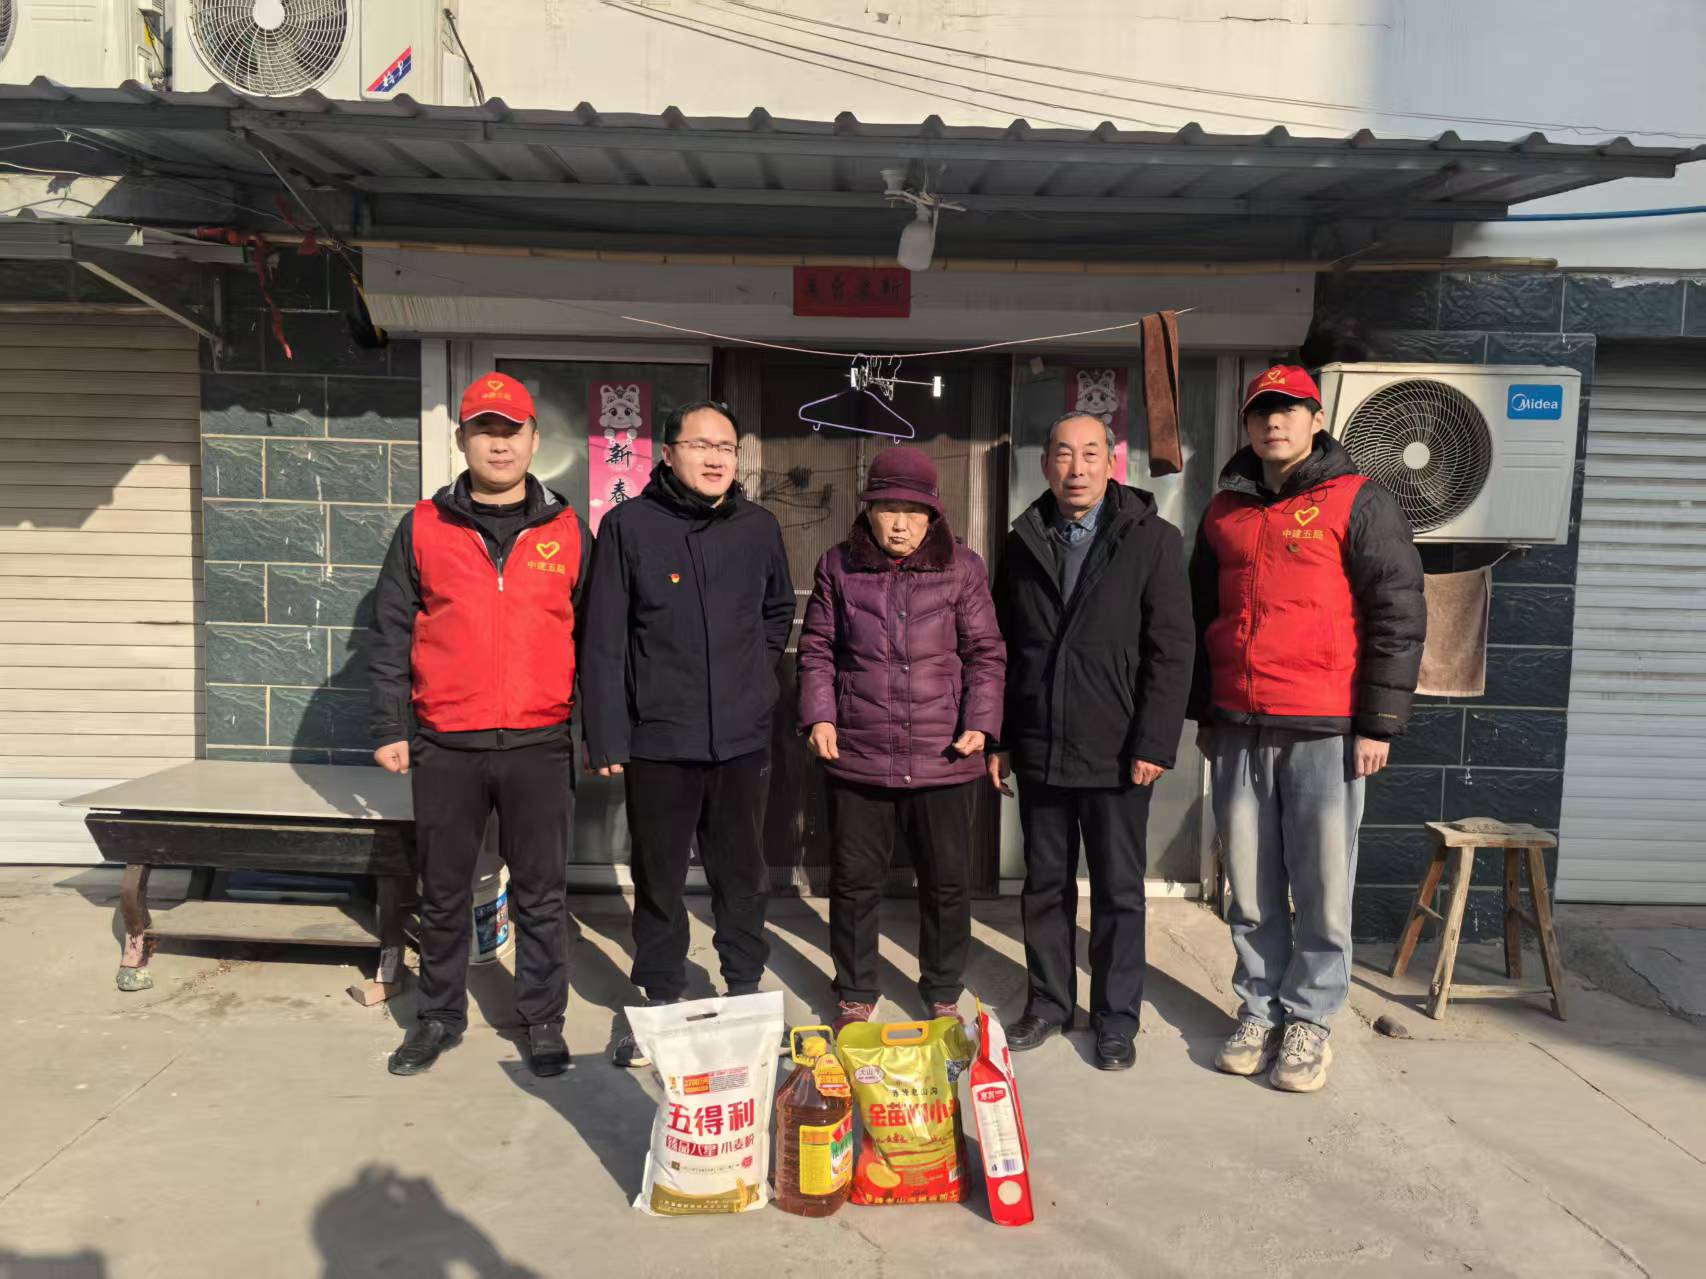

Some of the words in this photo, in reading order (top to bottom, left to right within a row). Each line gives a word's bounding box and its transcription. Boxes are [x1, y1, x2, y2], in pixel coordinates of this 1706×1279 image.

[1517, 397, 1558, 410] Midea
[605, 442, 632, 504] 新春
[1282, 528, 1324, 540] 中建五局
[667, 1098, 754, 1136] 五得利
[721, 1134, 754, 1154] 小麦粉
